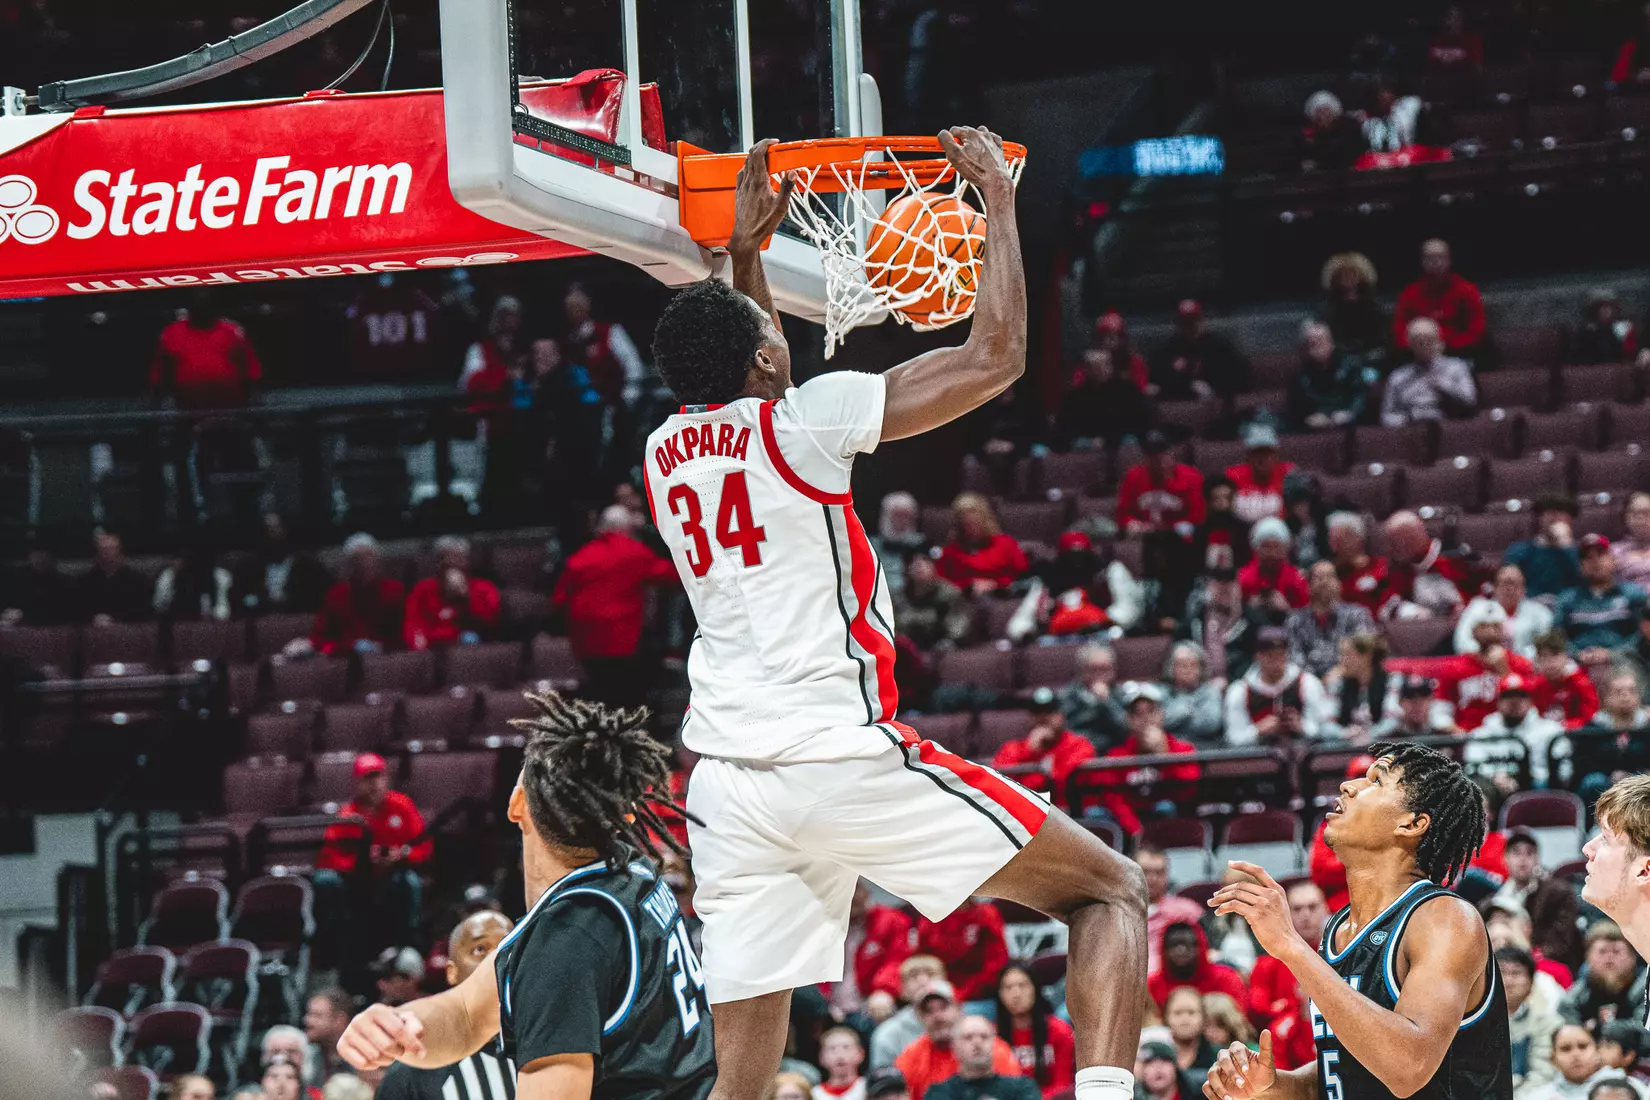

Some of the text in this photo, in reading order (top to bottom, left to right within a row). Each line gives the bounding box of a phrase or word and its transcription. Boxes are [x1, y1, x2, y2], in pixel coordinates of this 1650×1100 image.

[655, 423, 751, 477] OKPARA
[667, 470, 767, 579] 34
[666, 916, 712, 1038] 24
[1322, 1050, 1344, 1100] 5
